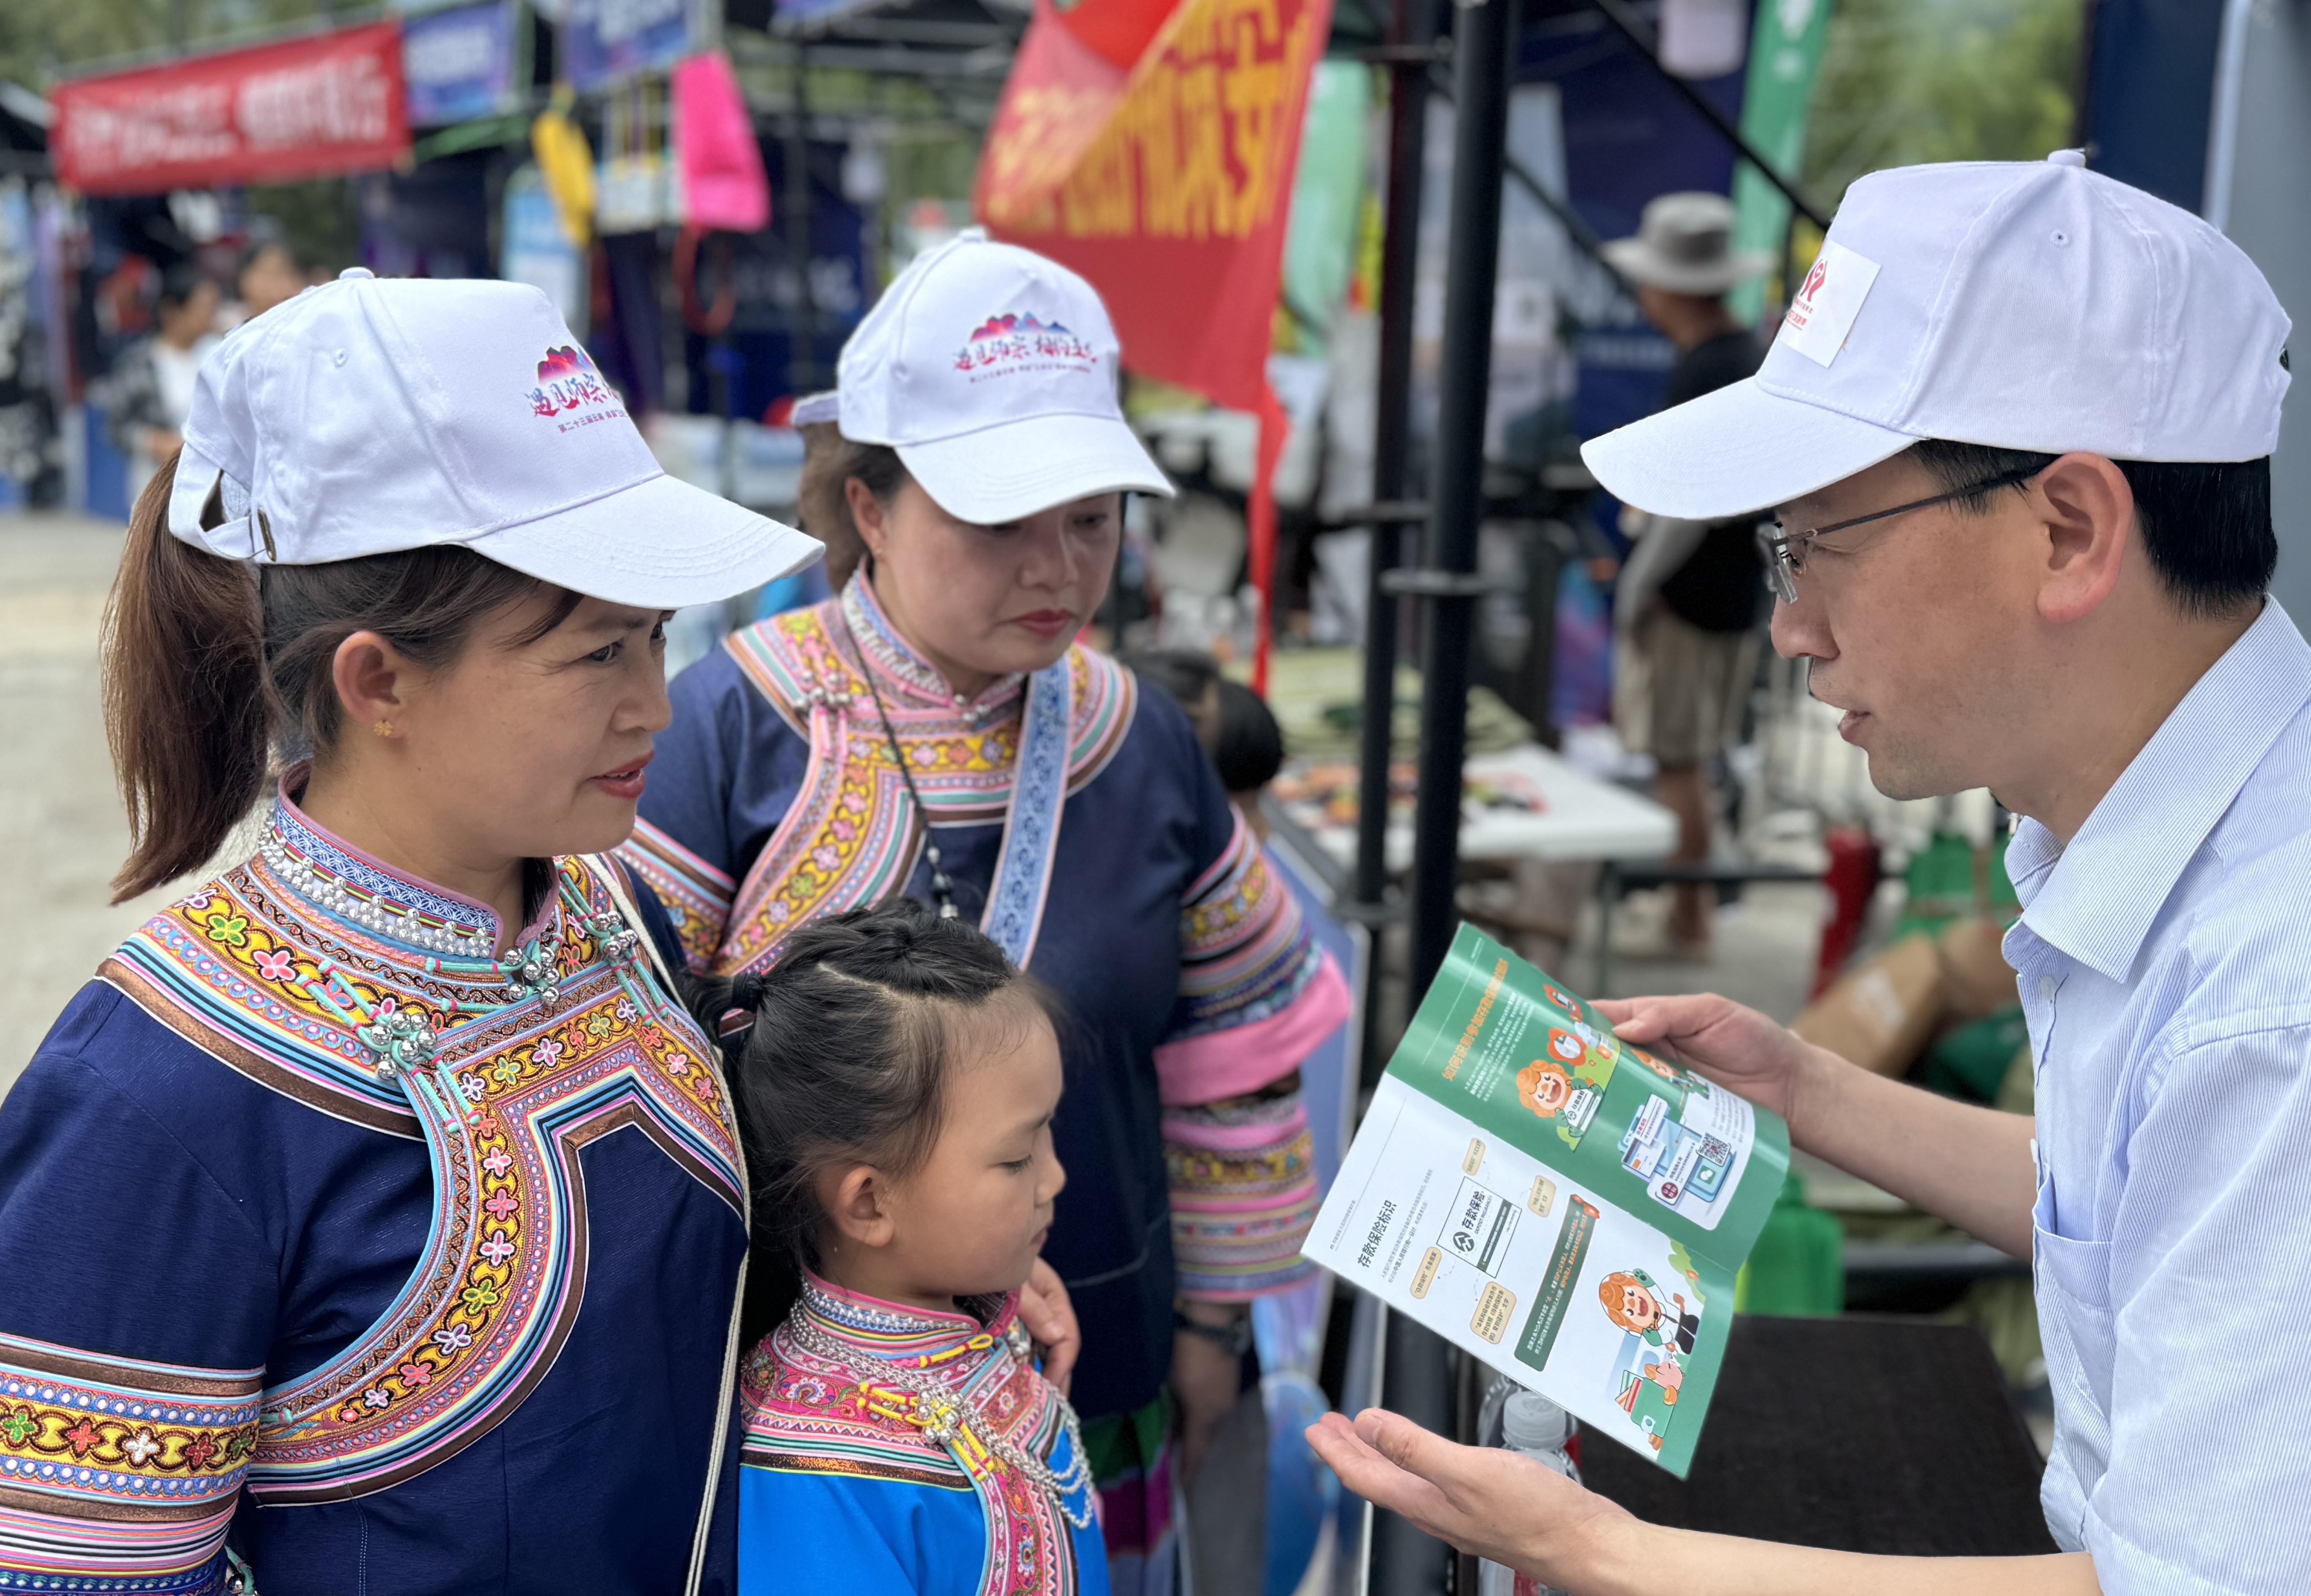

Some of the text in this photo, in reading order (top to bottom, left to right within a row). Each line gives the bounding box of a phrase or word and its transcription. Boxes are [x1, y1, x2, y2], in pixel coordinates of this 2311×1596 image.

[1356, 1198, 1397, 1269] 存款保险标识
[1461, 1189, 1485, 1231] 存款保险
